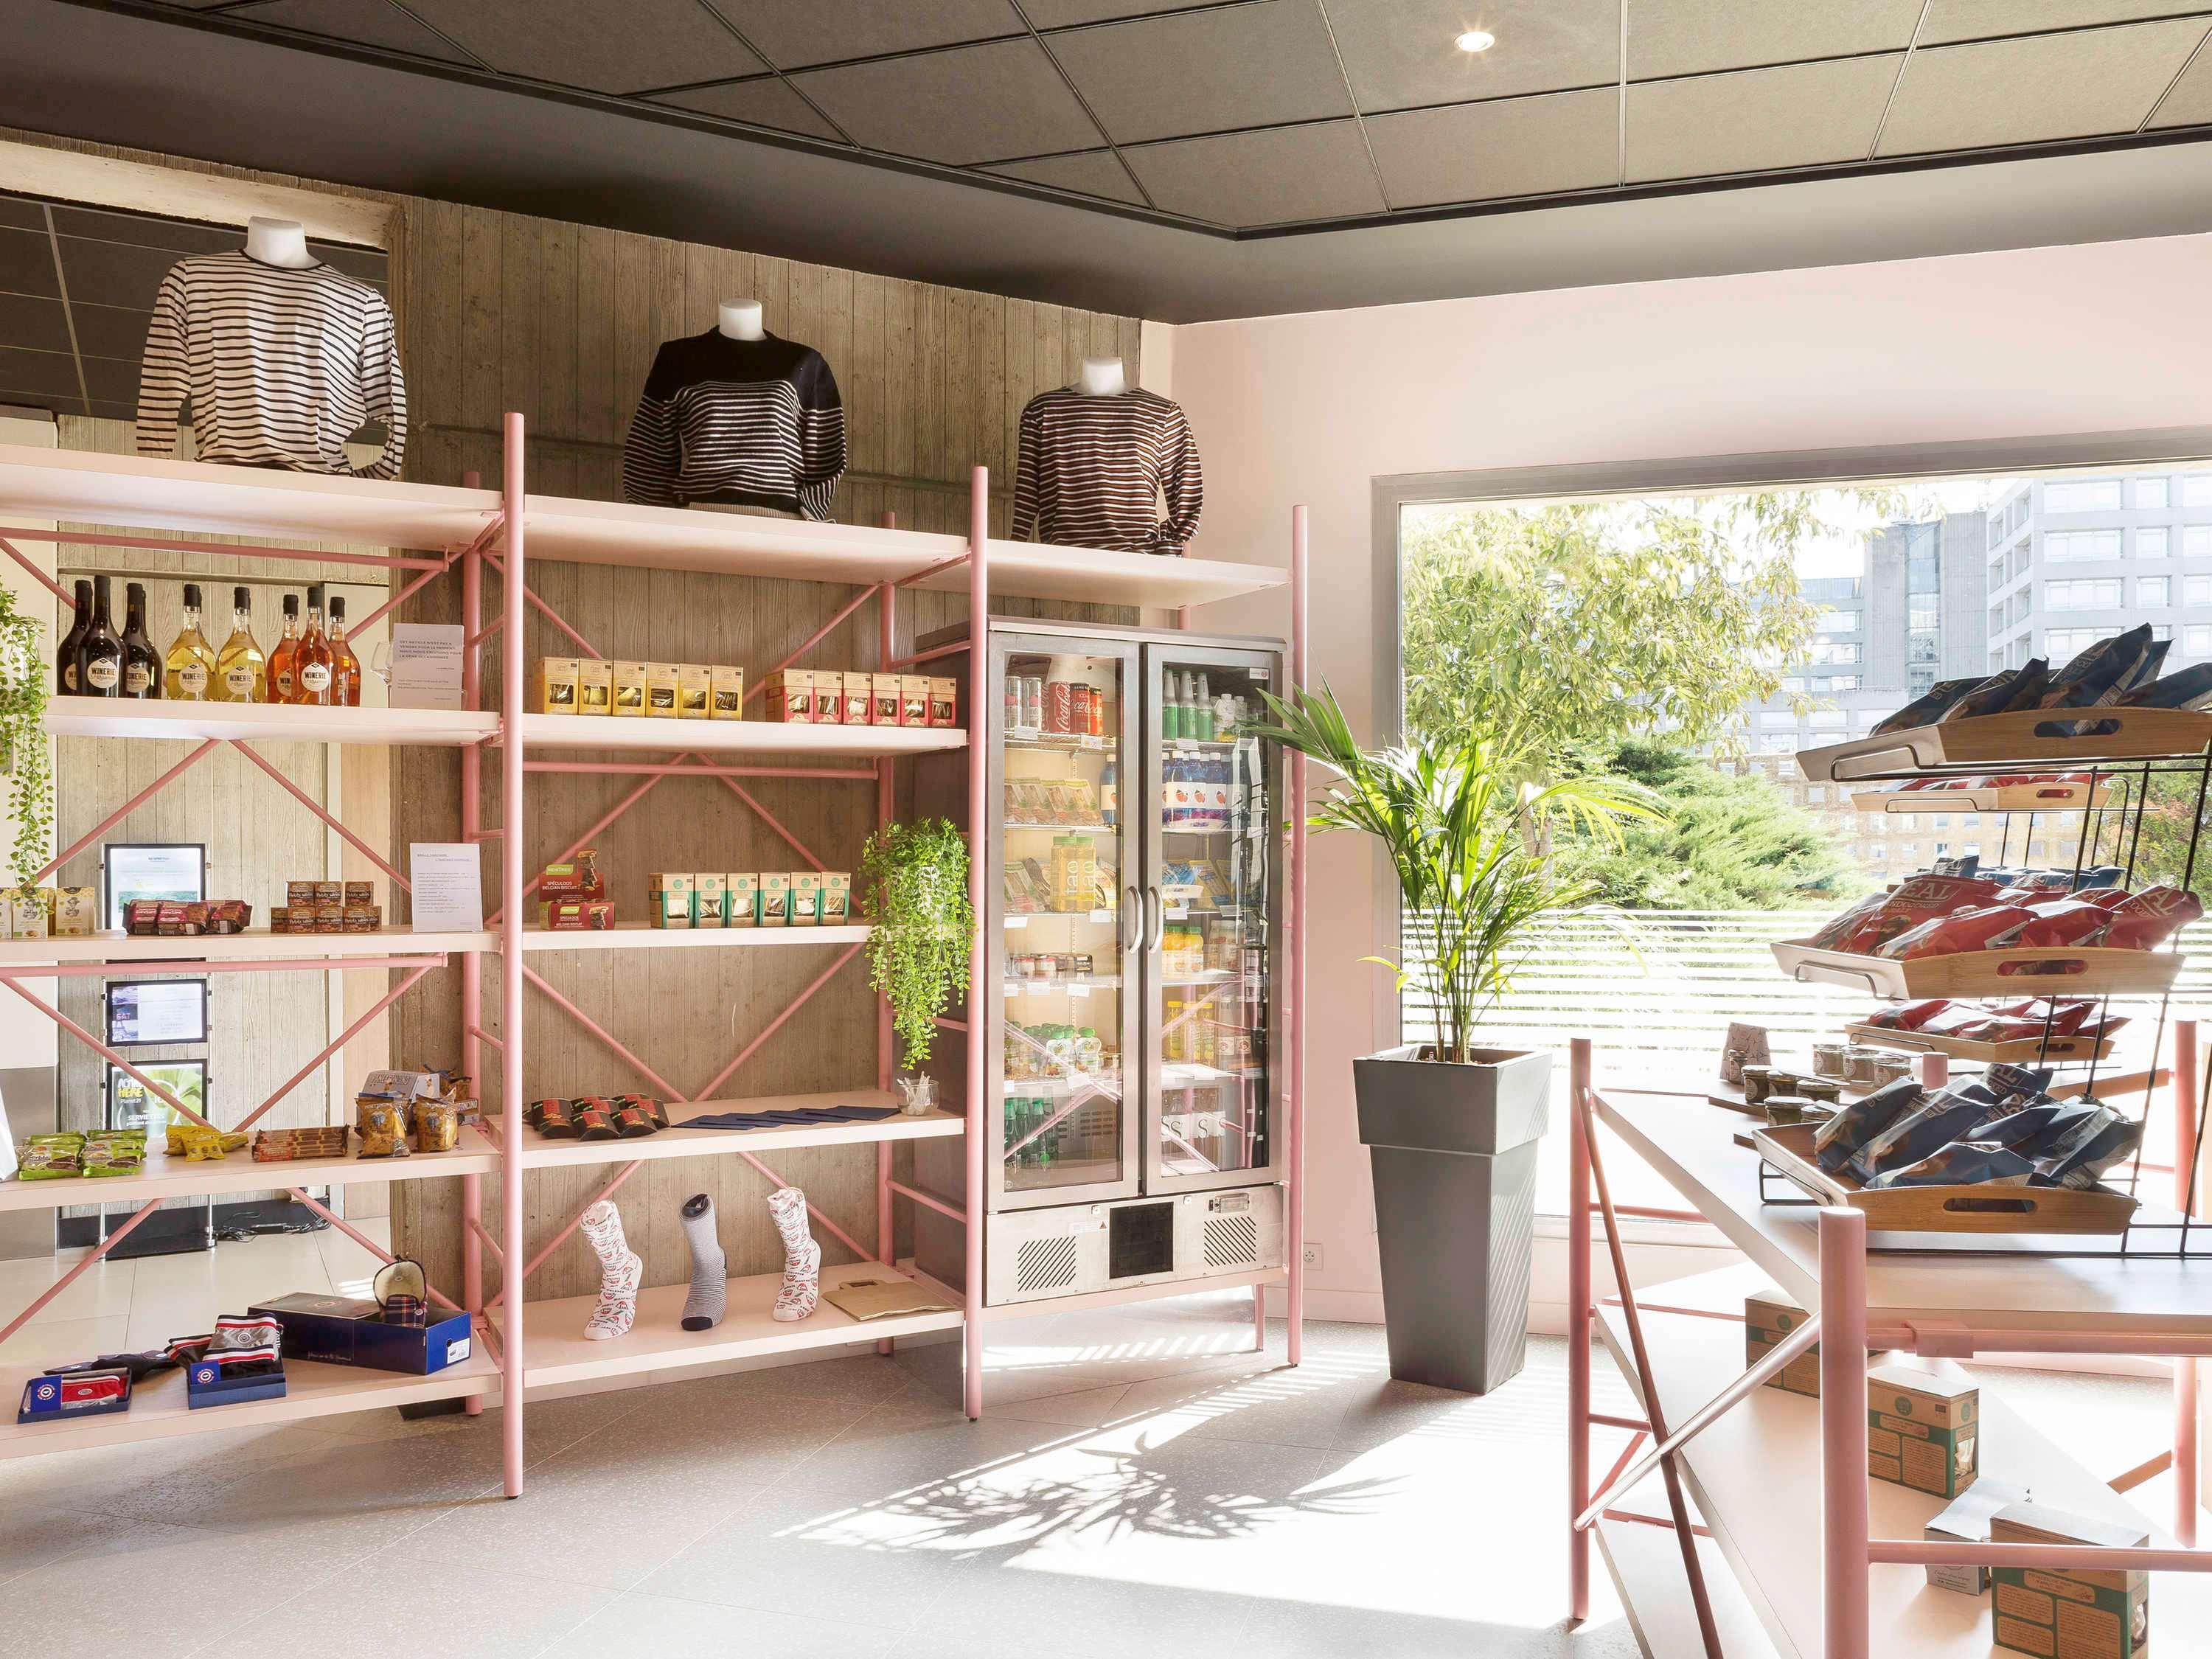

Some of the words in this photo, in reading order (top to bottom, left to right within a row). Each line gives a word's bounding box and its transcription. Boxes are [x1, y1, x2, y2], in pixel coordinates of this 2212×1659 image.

[91, 667, 116, 676] WINERIE
[126, 672, 147, 681] INERIE
[182, 672, 206, 681] WINERIE
[229, 674, 251, 682] WINERIE
[1899, 882, 1952, 900] EAL
[117, 1088, 144, 1098] HERE
